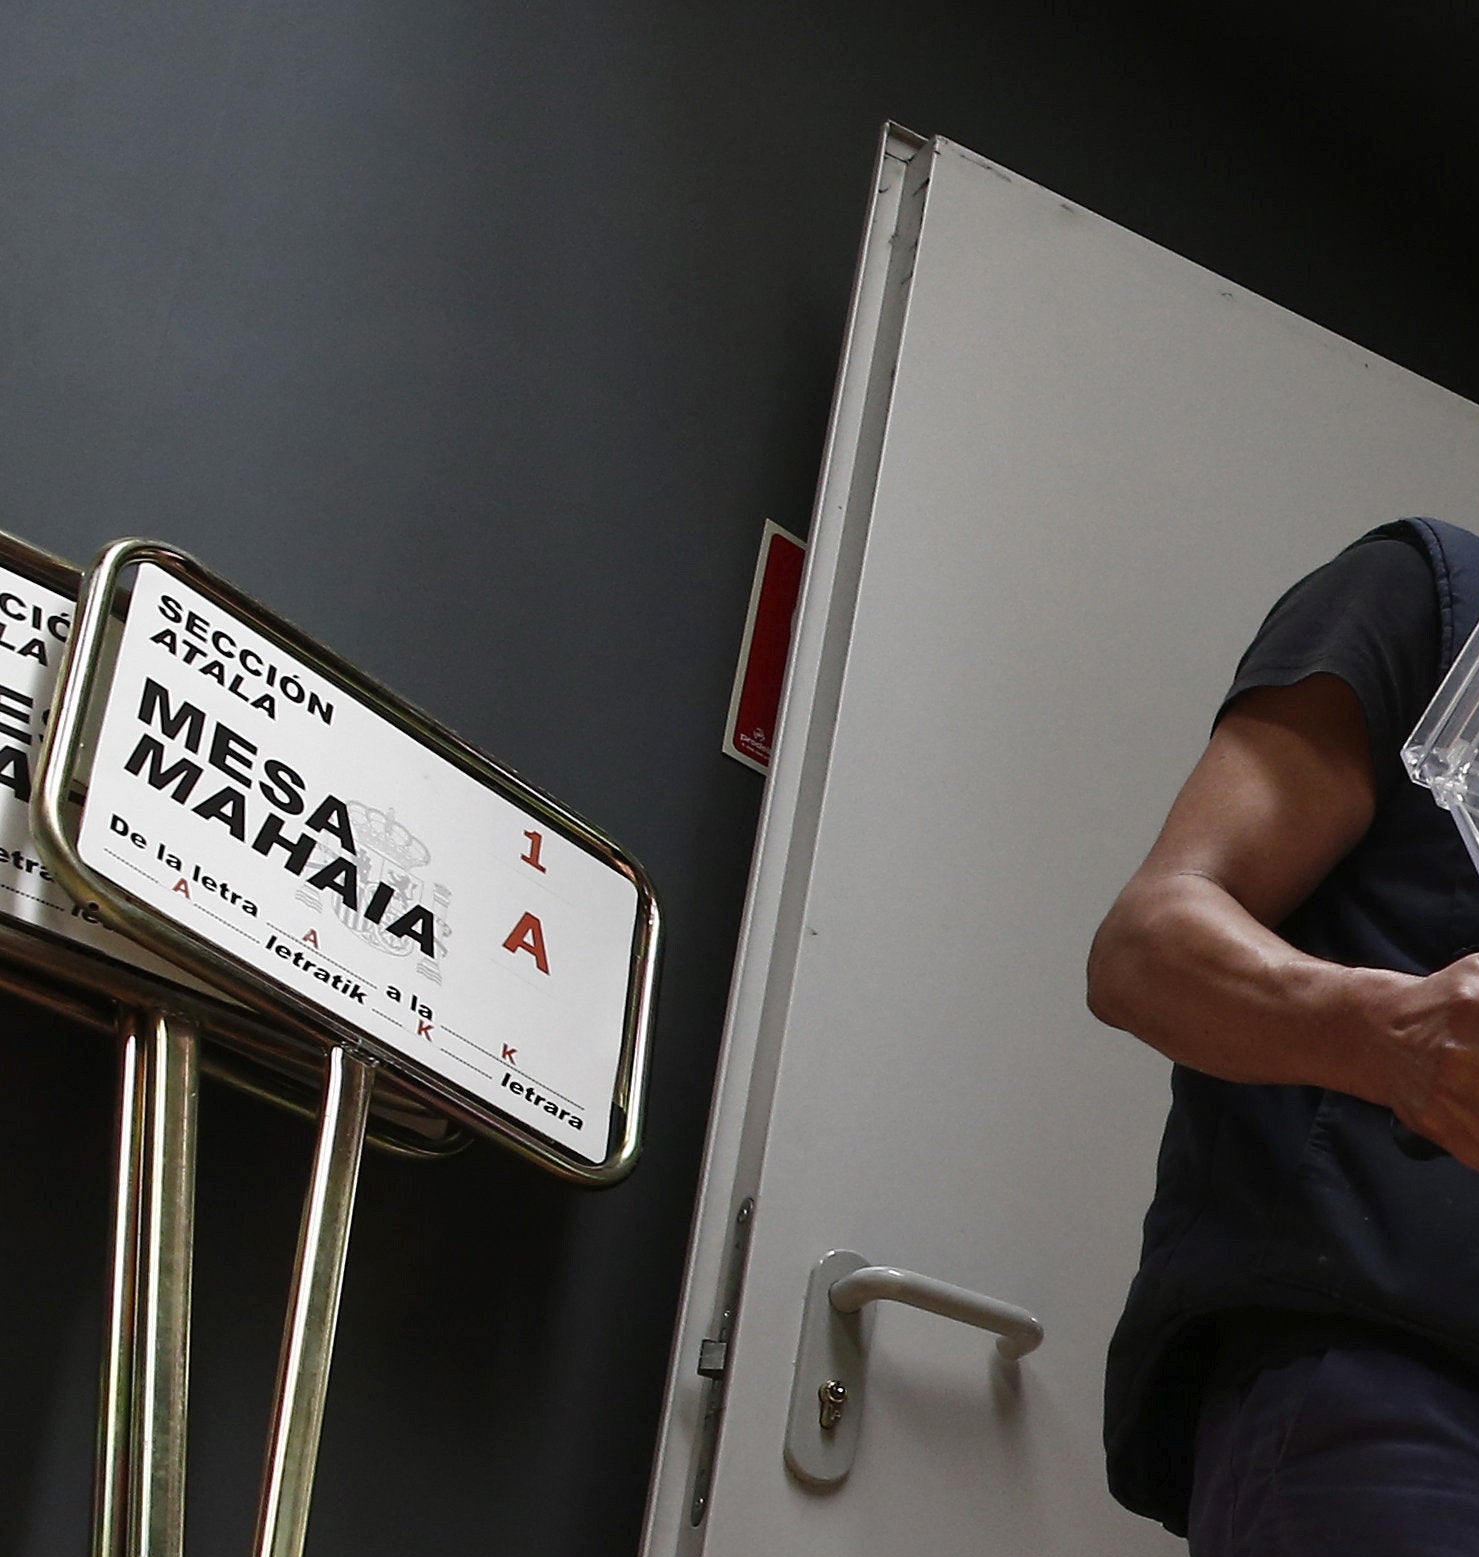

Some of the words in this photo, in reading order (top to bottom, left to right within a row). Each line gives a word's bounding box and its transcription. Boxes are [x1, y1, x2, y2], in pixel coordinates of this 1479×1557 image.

[149, 628, 277, 720] ATALA
[157, 593, 335, 726] SECCIÓN
[137, 676, 358, 857] MESA
[123, 733, 435, 959] MAHAIA
[520, 829, 547, 874] 1
[110, 814, 147, 849] De
[157, 843, 182, 872] la
[192, 864, 259, 917] letra
[302, 928, 320, 950] A
[386, 985, 402, 1003] a
[410, 994, 433, 1021] la
[501, 1042, 518, 1066] K
[172, 877, 191, 899] A
[265, 935, 368, 1005] letratik
[417, 1019, 435, 1042] K
[500, 1072, 585, 1131] letrara
[501, 911, 550, 976] A
